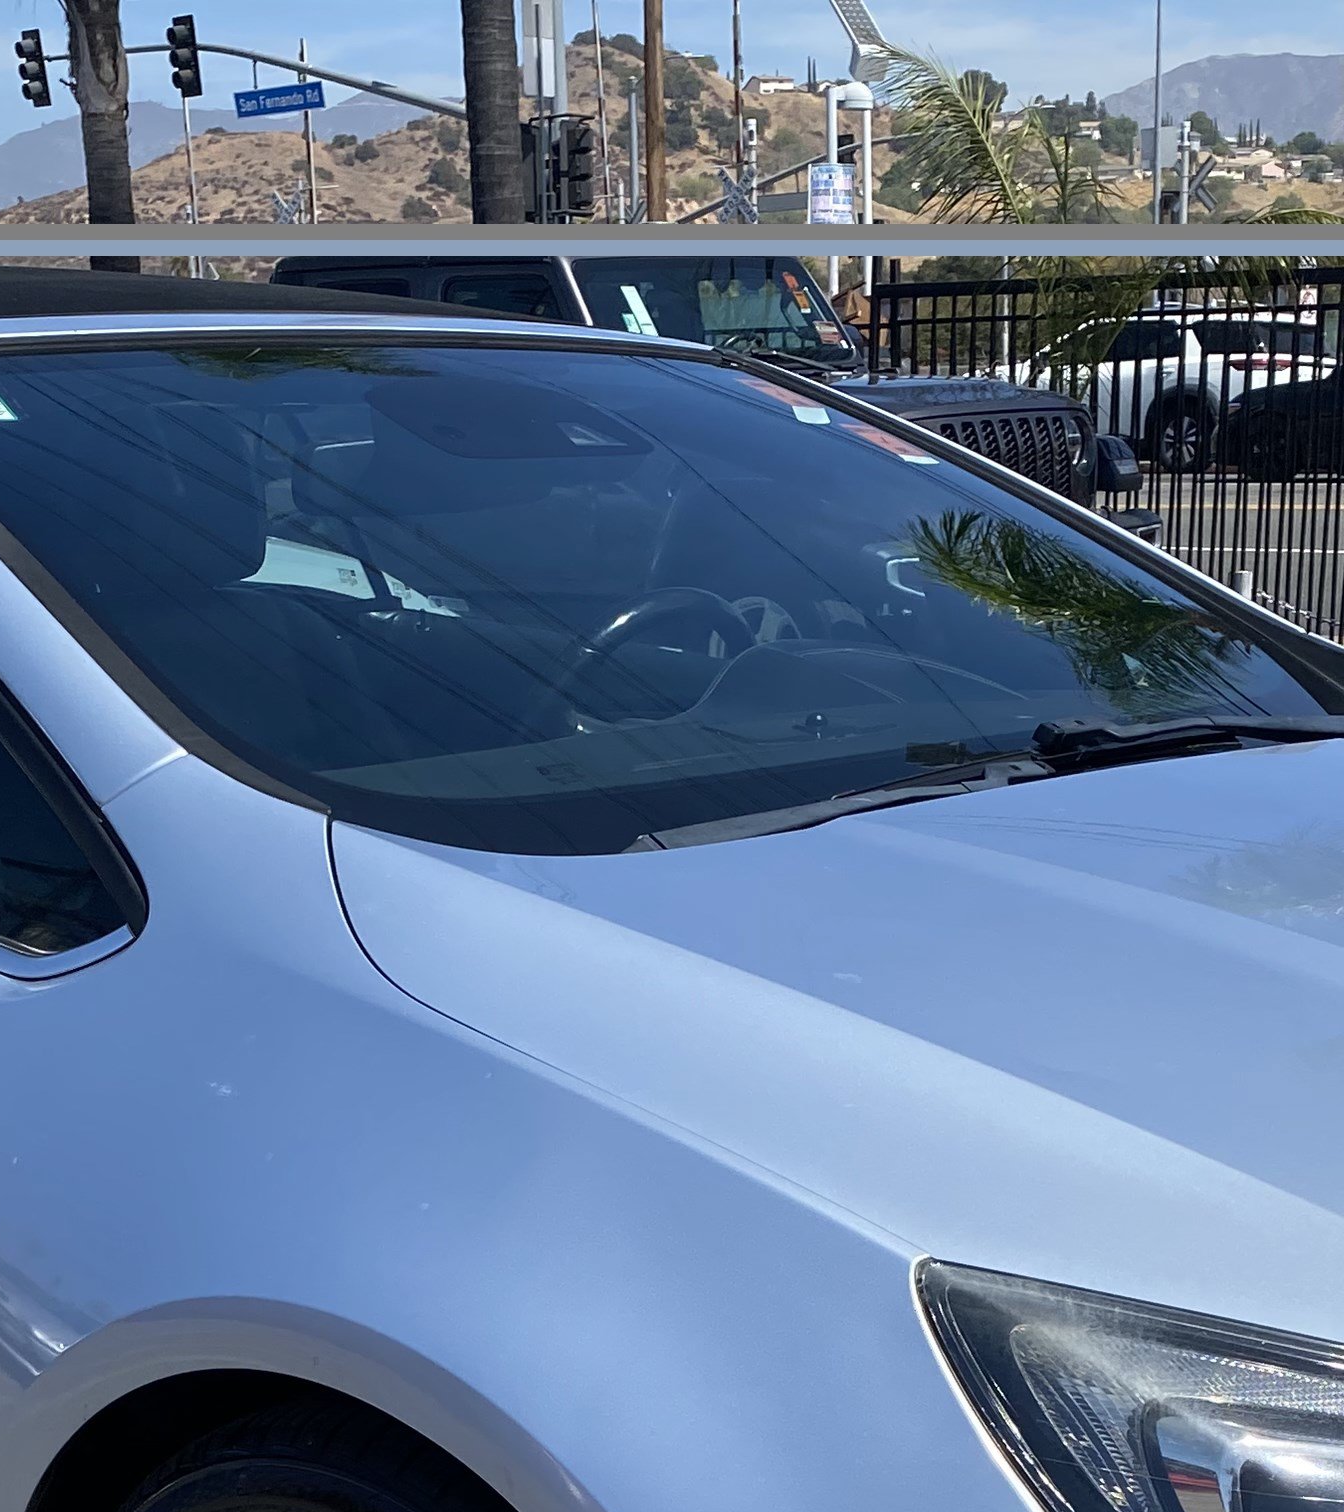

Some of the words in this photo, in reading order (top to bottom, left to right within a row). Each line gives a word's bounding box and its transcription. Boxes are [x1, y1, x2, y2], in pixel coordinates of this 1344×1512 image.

[239, 98, 258, 112] San
[258, 92, 305, 109] Fernando
[305, 88, 320, 103] Rd
